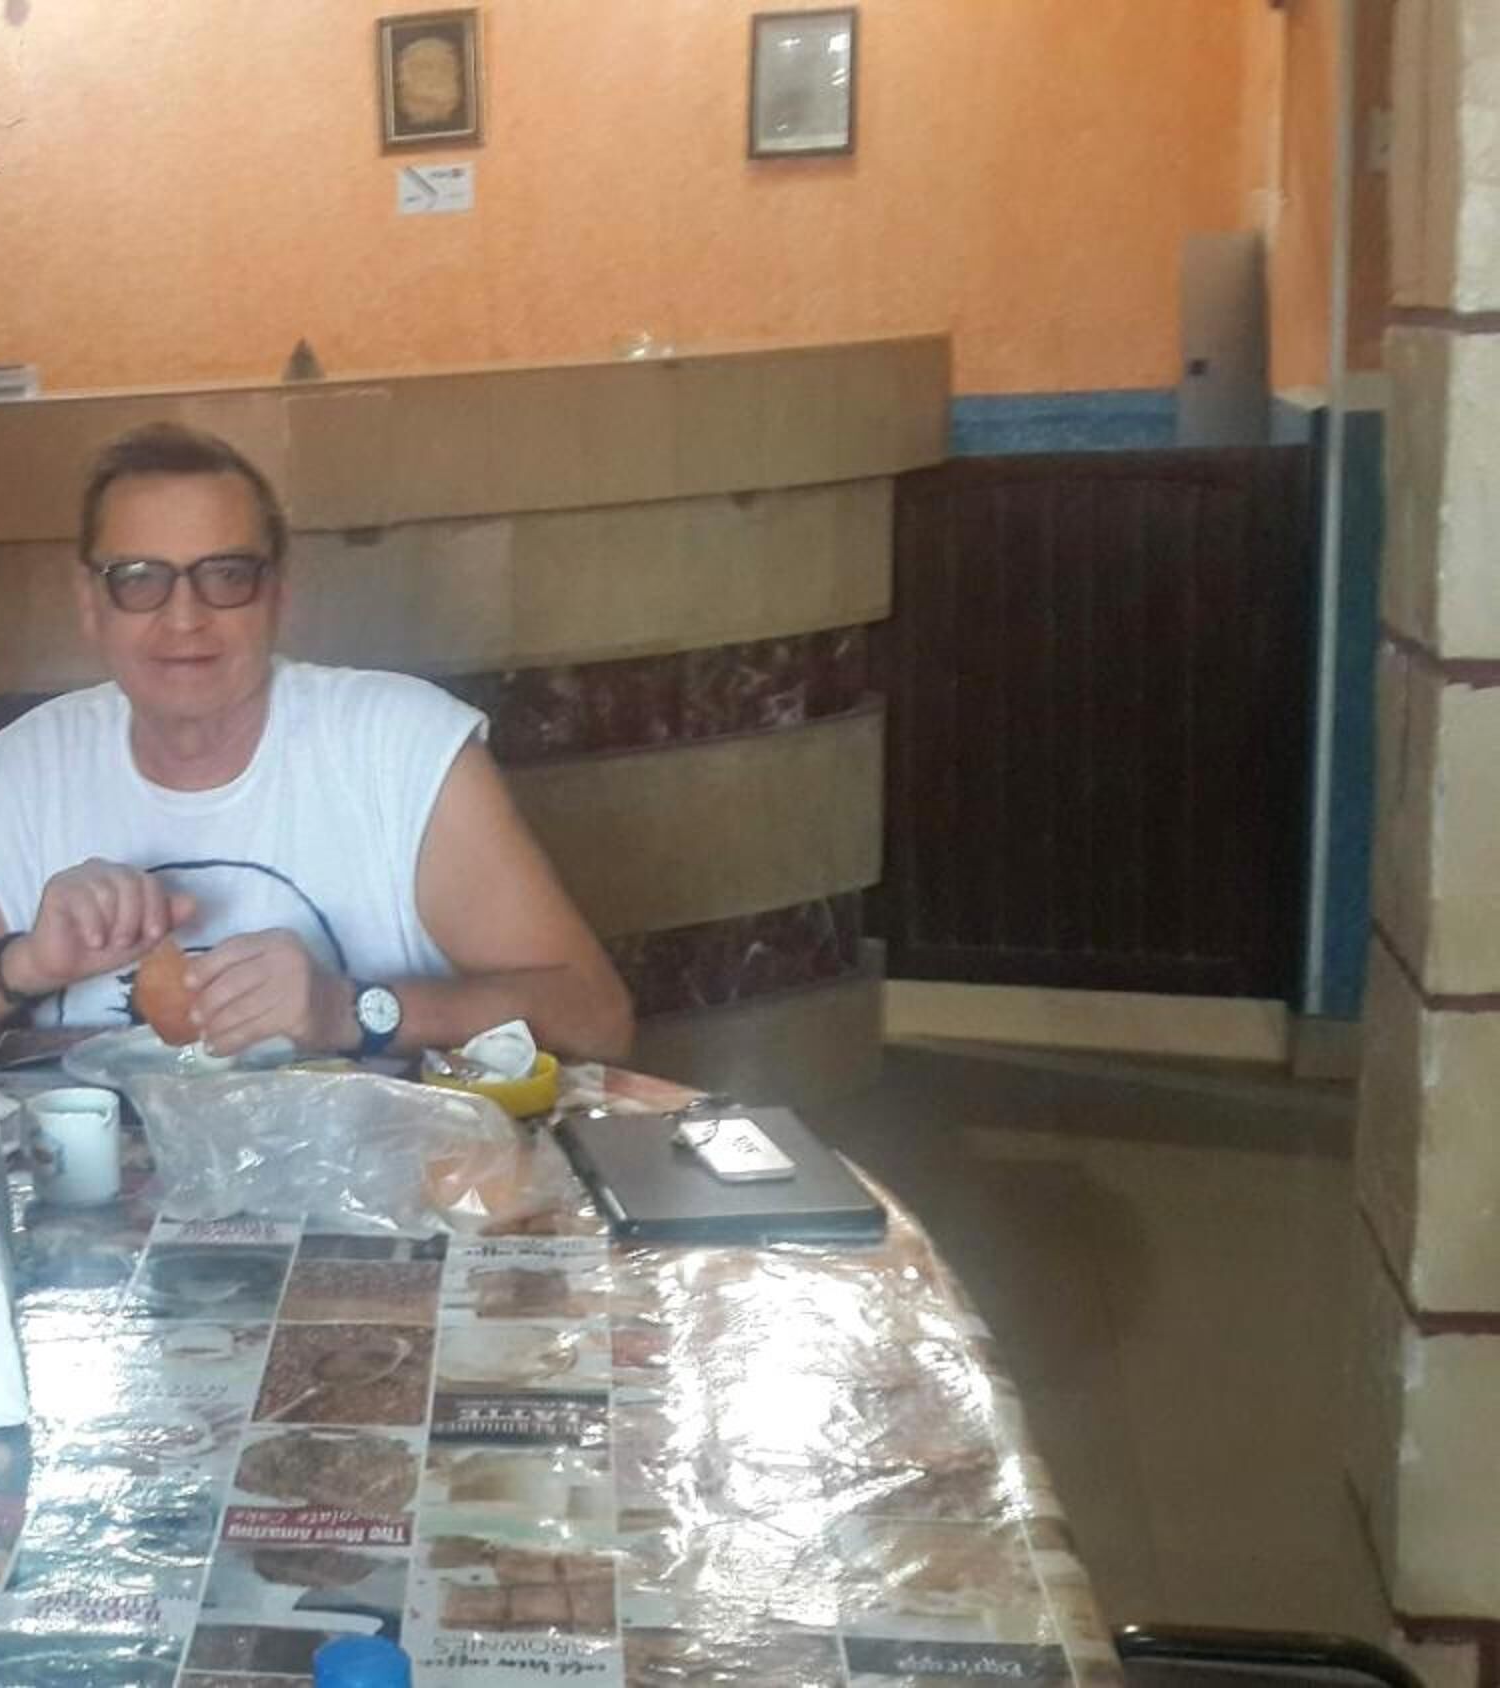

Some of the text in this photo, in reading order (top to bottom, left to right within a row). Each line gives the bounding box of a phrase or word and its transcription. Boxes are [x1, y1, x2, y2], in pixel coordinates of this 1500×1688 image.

[459, 1408, 581, 1422] LATTE
[231, 1510, 288, 1525] Cake
[227, 1523, 406, 1543] The Most Amazing
